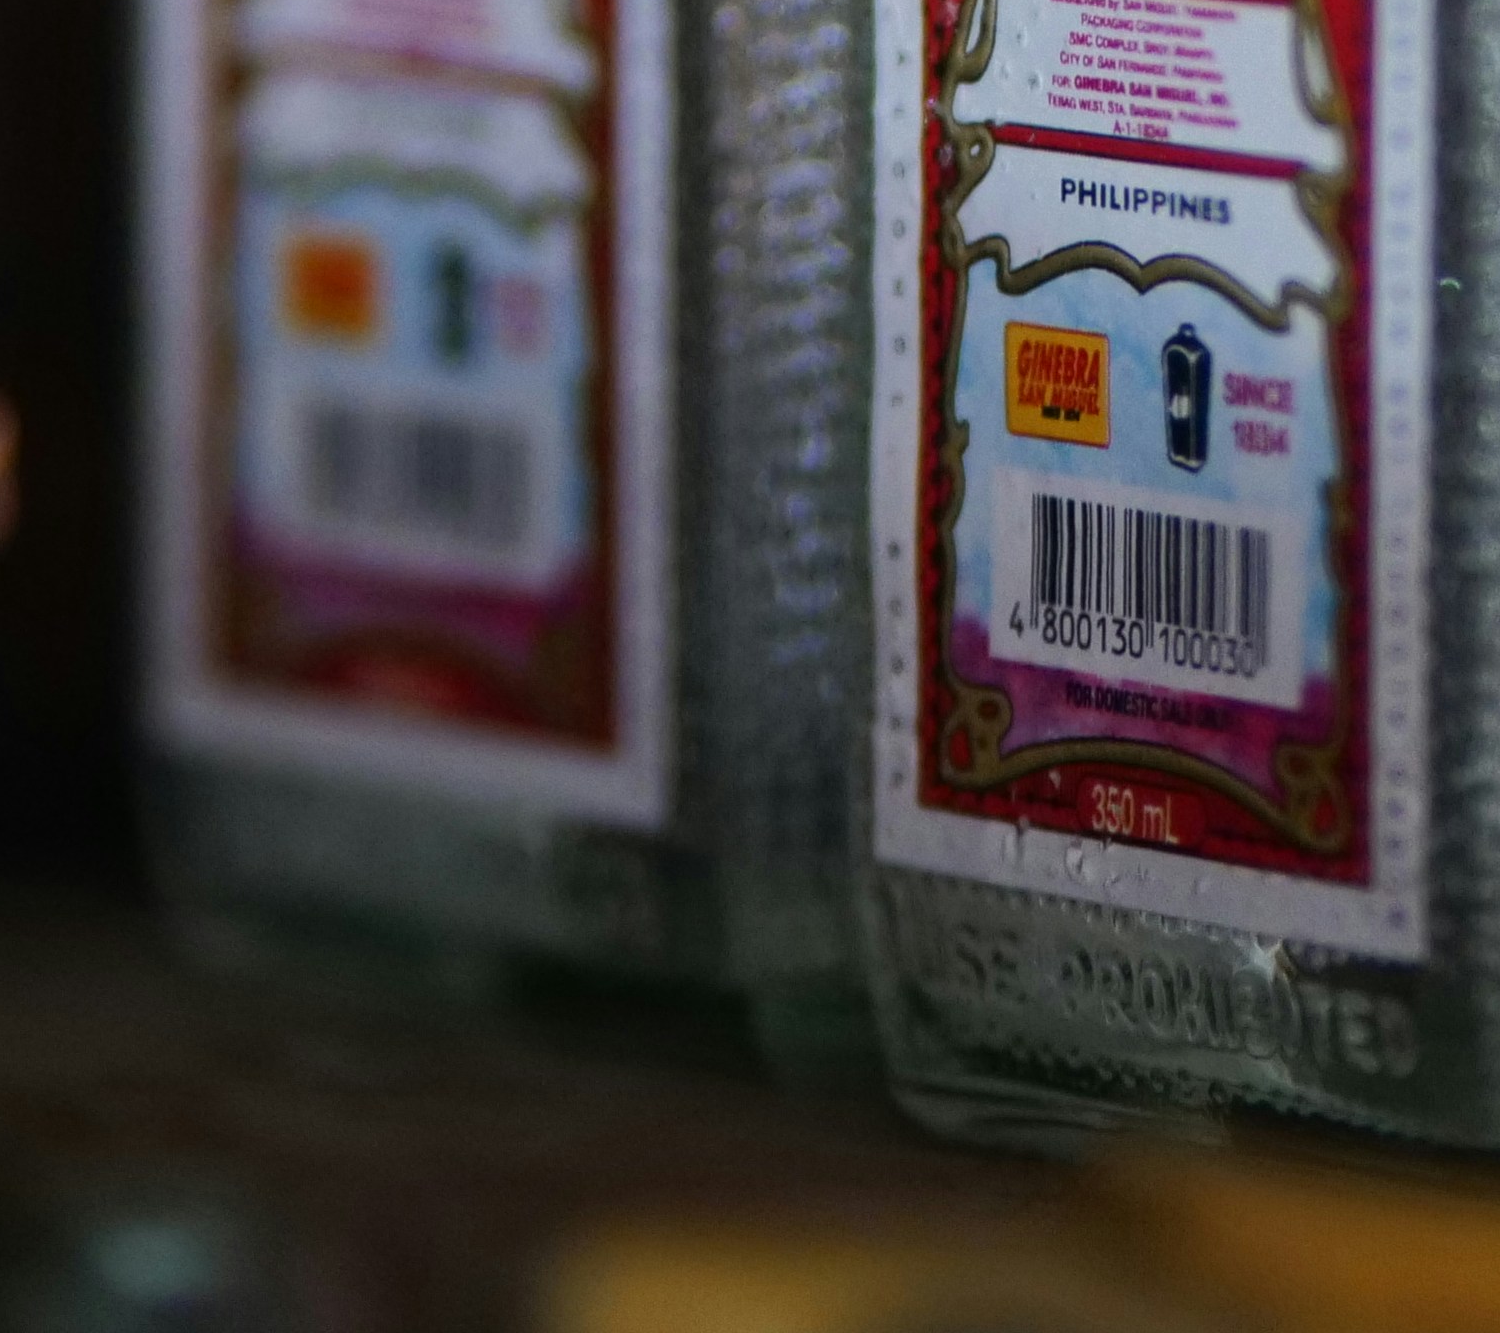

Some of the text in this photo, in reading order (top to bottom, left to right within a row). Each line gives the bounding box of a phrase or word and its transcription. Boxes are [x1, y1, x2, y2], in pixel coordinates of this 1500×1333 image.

[1060, 51, 1080, 65] CITY
[1074, 75, 1126, 95] GINEBRA
[1060, 177, 1232, 227] PHILIPPINES
[1017, 339, 1099, 389] GINEBRA
[1008, 600, 1257, 679] 4 800130 100030
[1091, 783, 1179, 844] 350 mL
